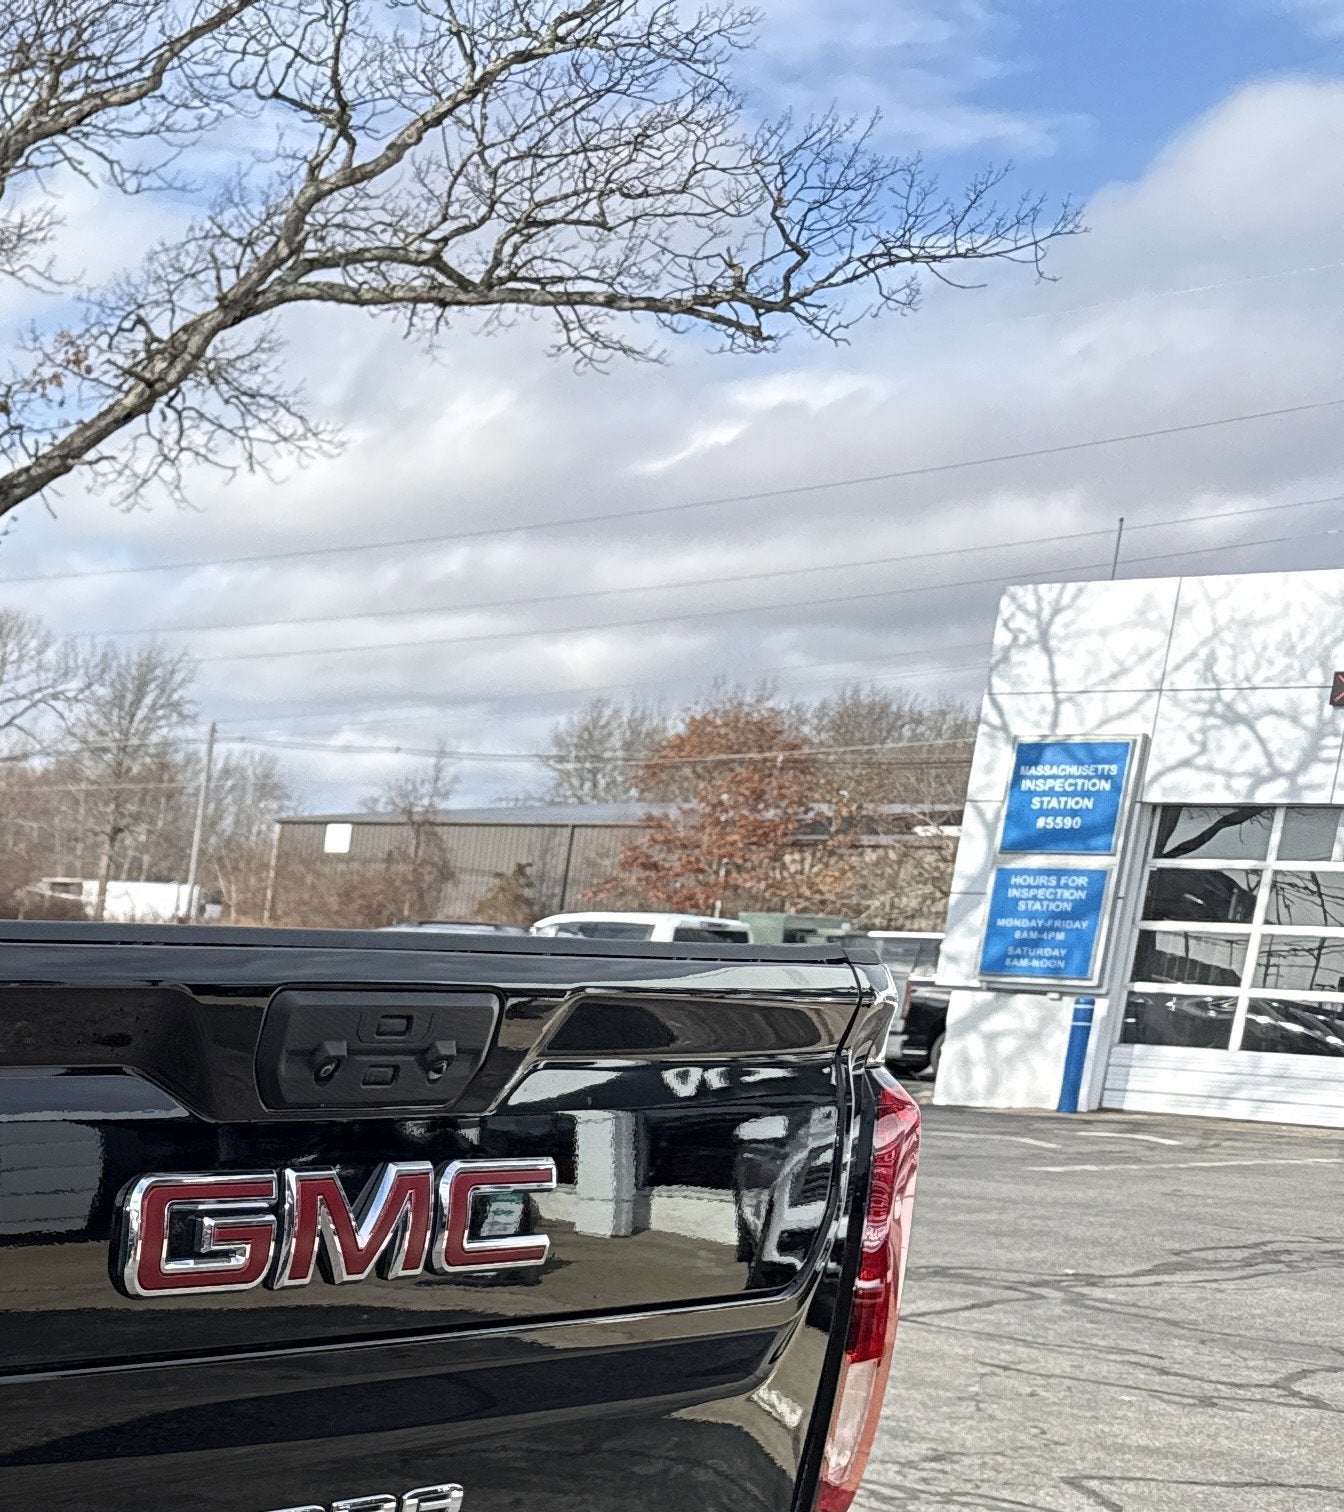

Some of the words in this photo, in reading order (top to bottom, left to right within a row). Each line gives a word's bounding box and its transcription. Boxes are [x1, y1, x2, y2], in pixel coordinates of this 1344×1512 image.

[1020, 764, 1118, 776] MASSACHUSETTS
[1020, 778, 1111, 792] INSPECTION
[1030, 796, 1094, 810] STATION
[1036, 816, 1082, 830] #5590
[1010, 874, 1057, 887] HOURS
[1060, 876, 1089, 888] FOR
[1007, 887, 1087, 900] INSPECTION
[1017, 900, 1073, 912] STATION
[1007, 946, 1068, 957] SATURDAY
[116, 1156, 558, 1298] GMC
